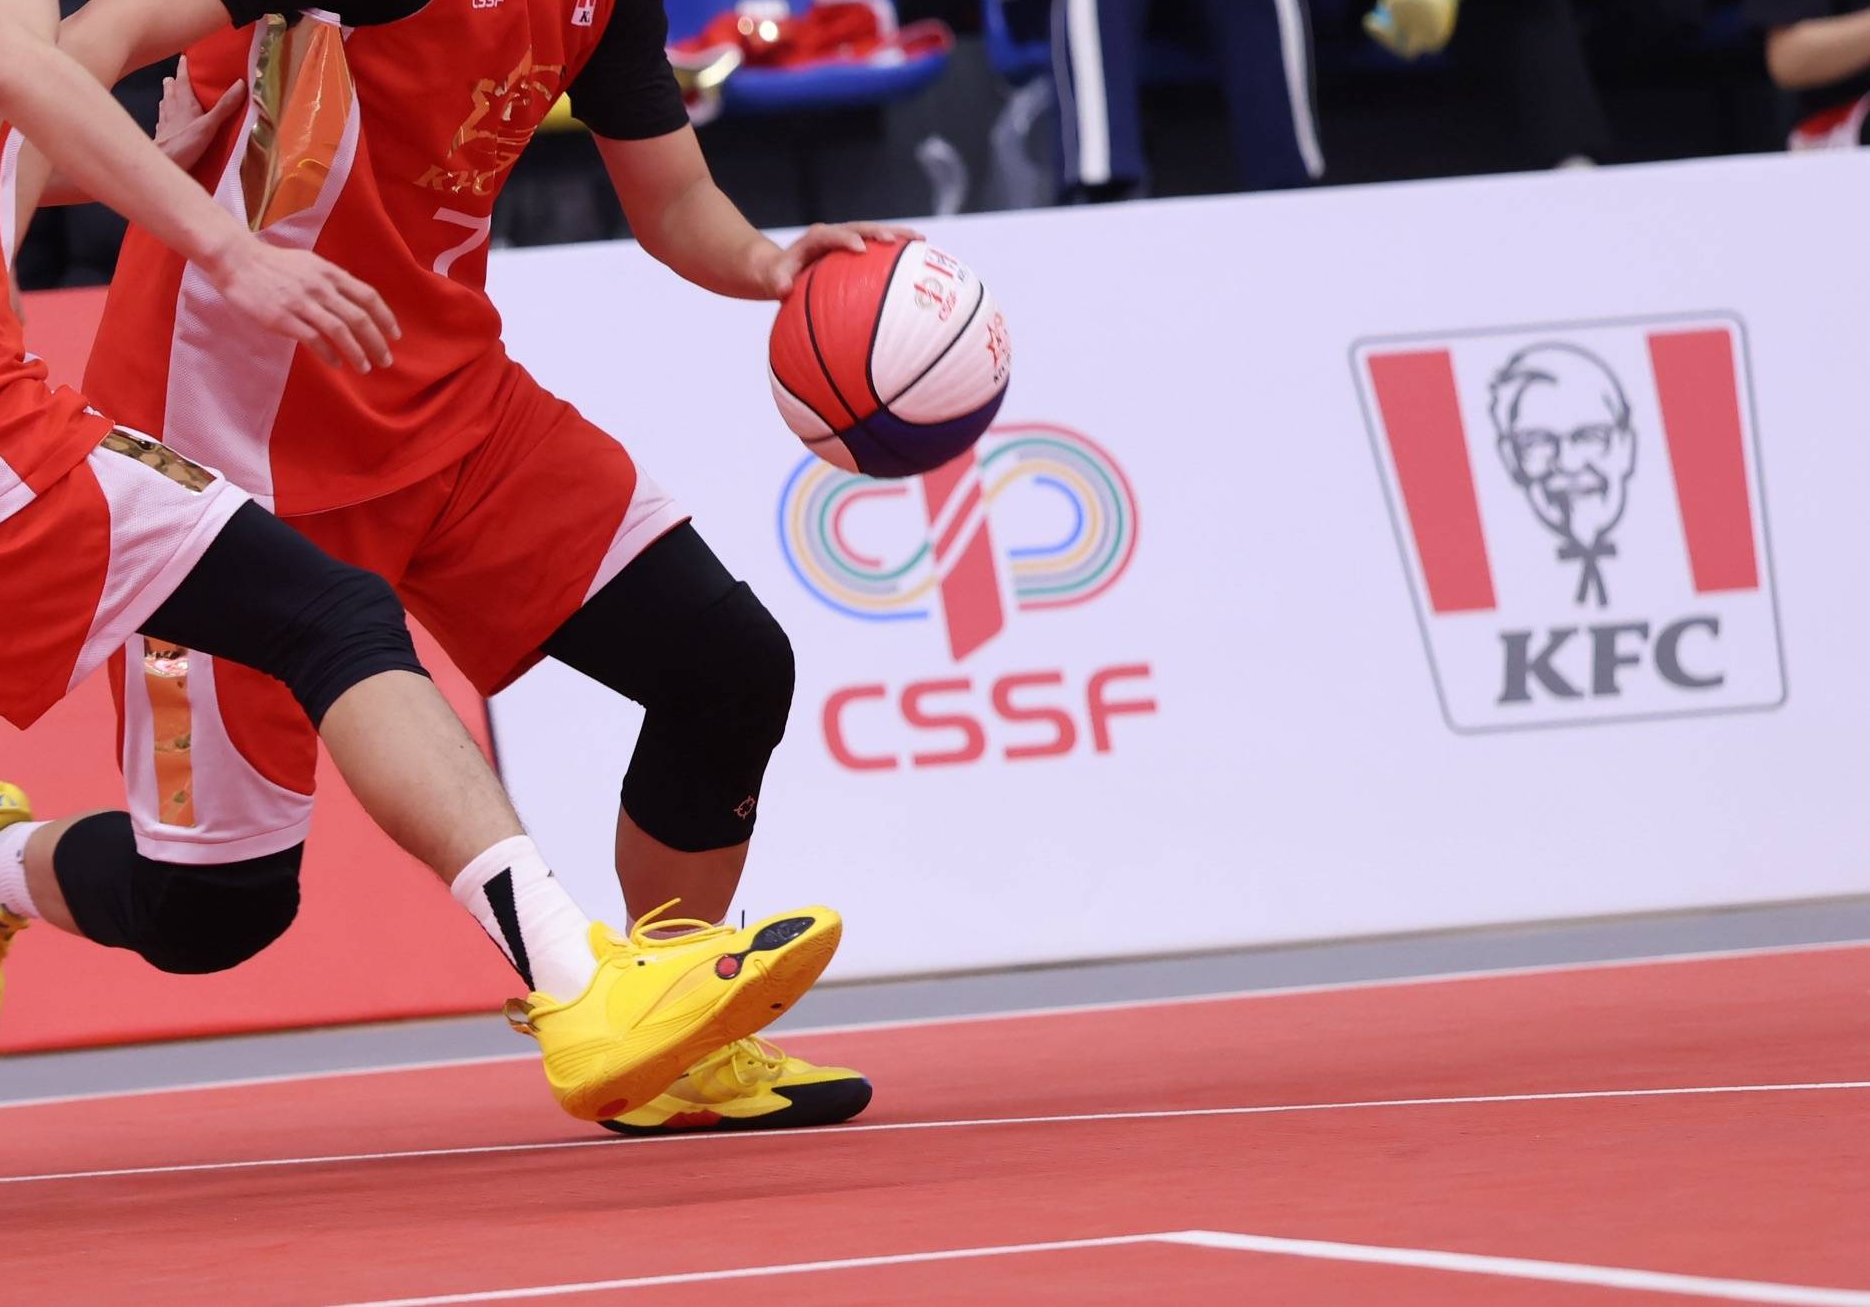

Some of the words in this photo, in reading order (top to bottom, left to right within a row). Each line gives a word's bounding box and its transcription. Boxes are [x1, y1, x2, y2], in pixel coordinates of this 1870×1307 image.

[432, 206, 492, 279] 7
[1498, 615, 1726, 706] KFC
[822, 662, 1157, 772] CSSF
